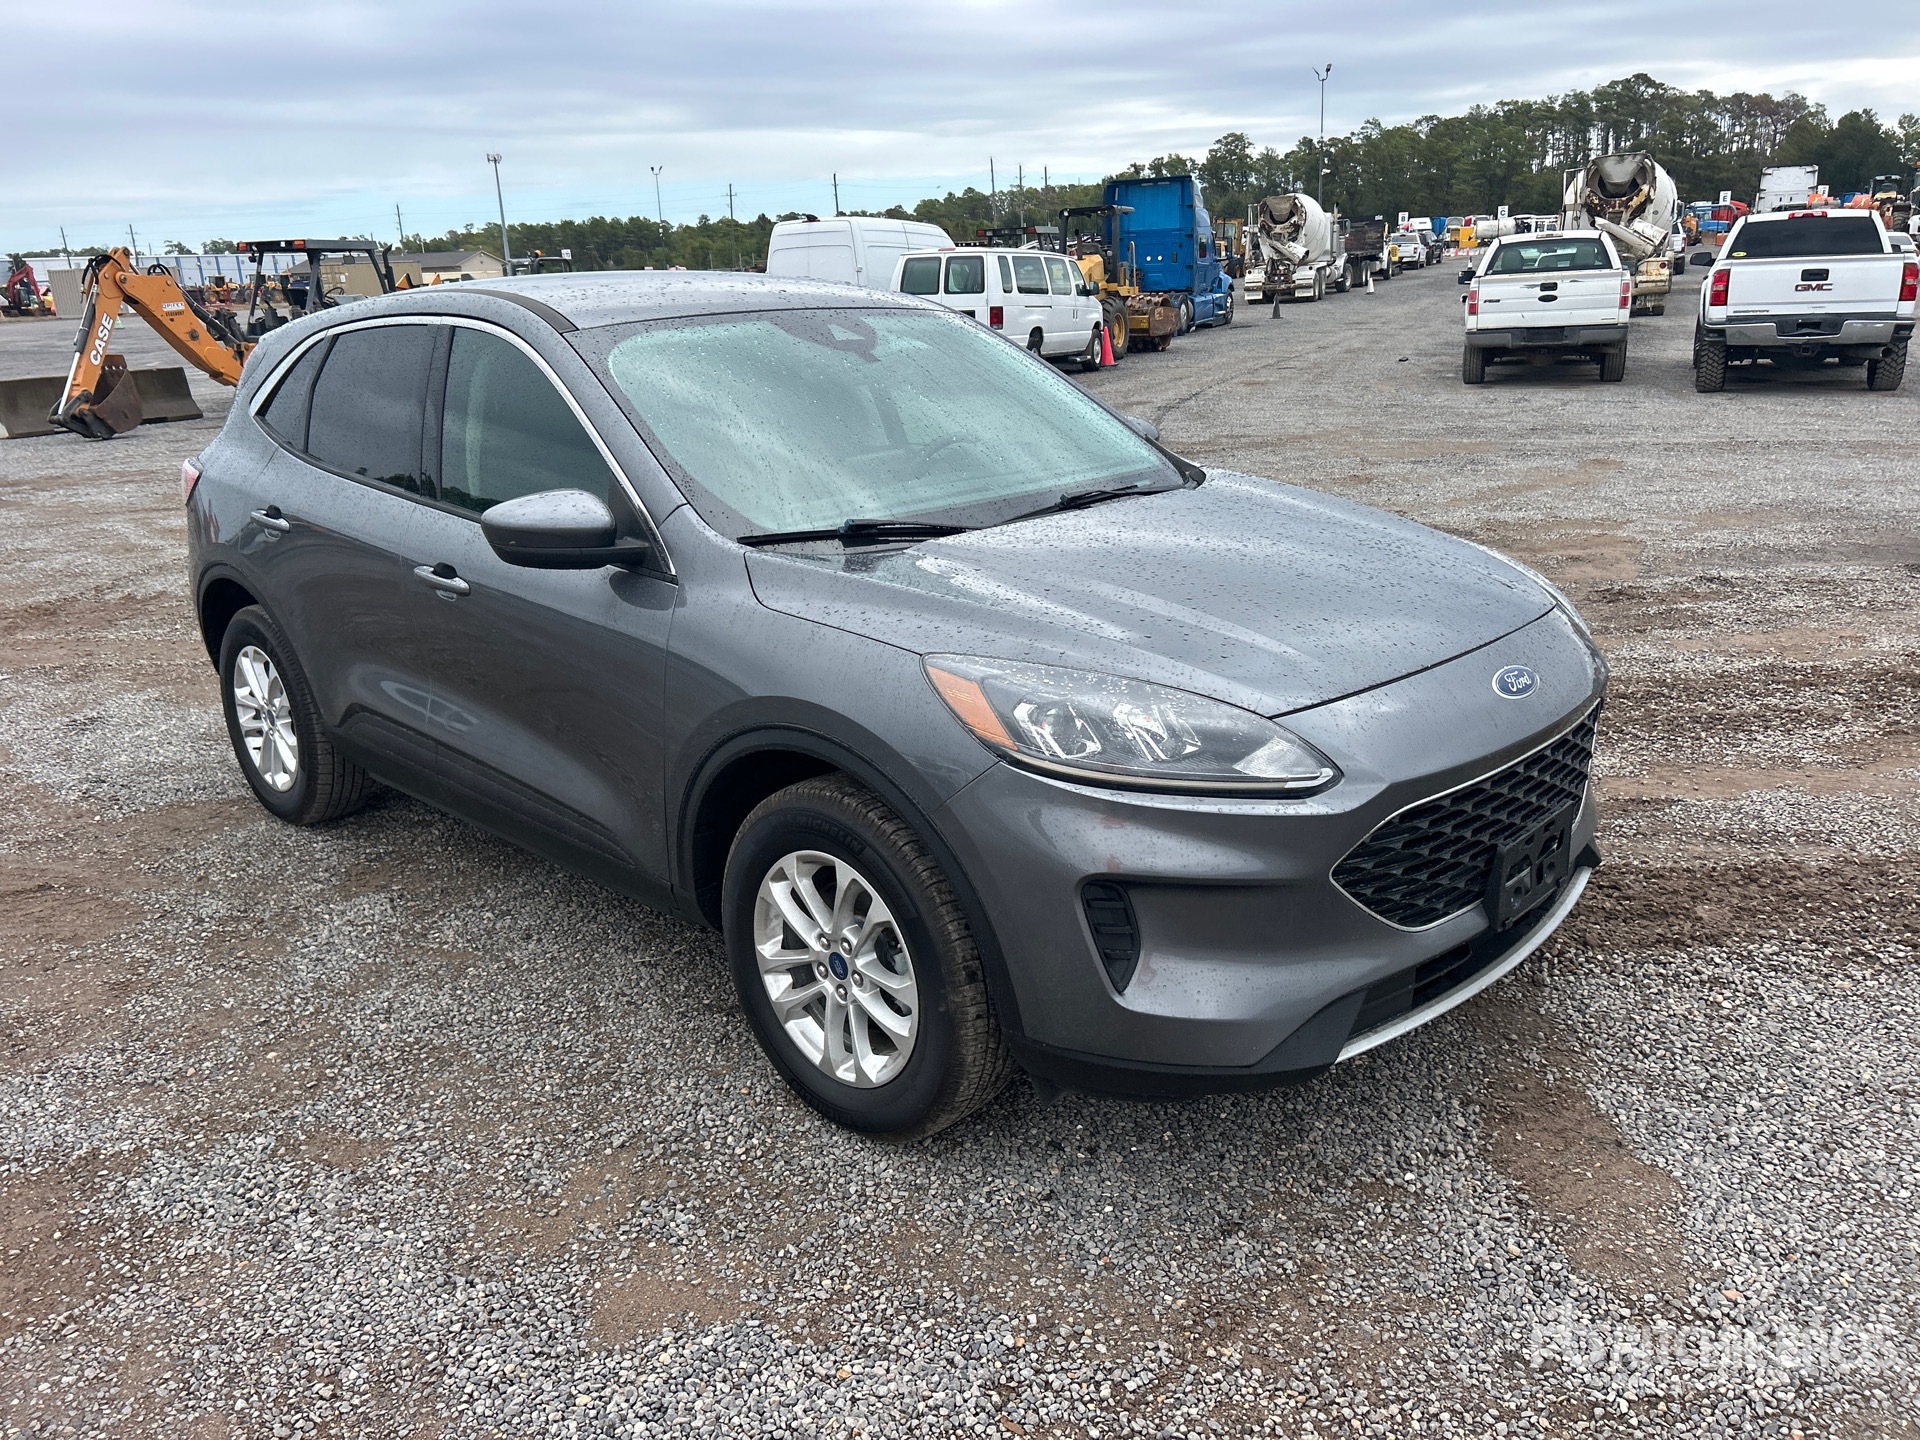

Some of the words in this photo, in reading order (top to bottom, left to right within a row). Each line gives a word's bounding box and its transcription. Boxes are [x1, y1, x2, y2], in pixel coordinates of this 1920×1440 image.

[1795, 283, 1833, 292] GMC
[90, 312, 114, 366] CASE
[1503, 670, 1532, 692] Ford
